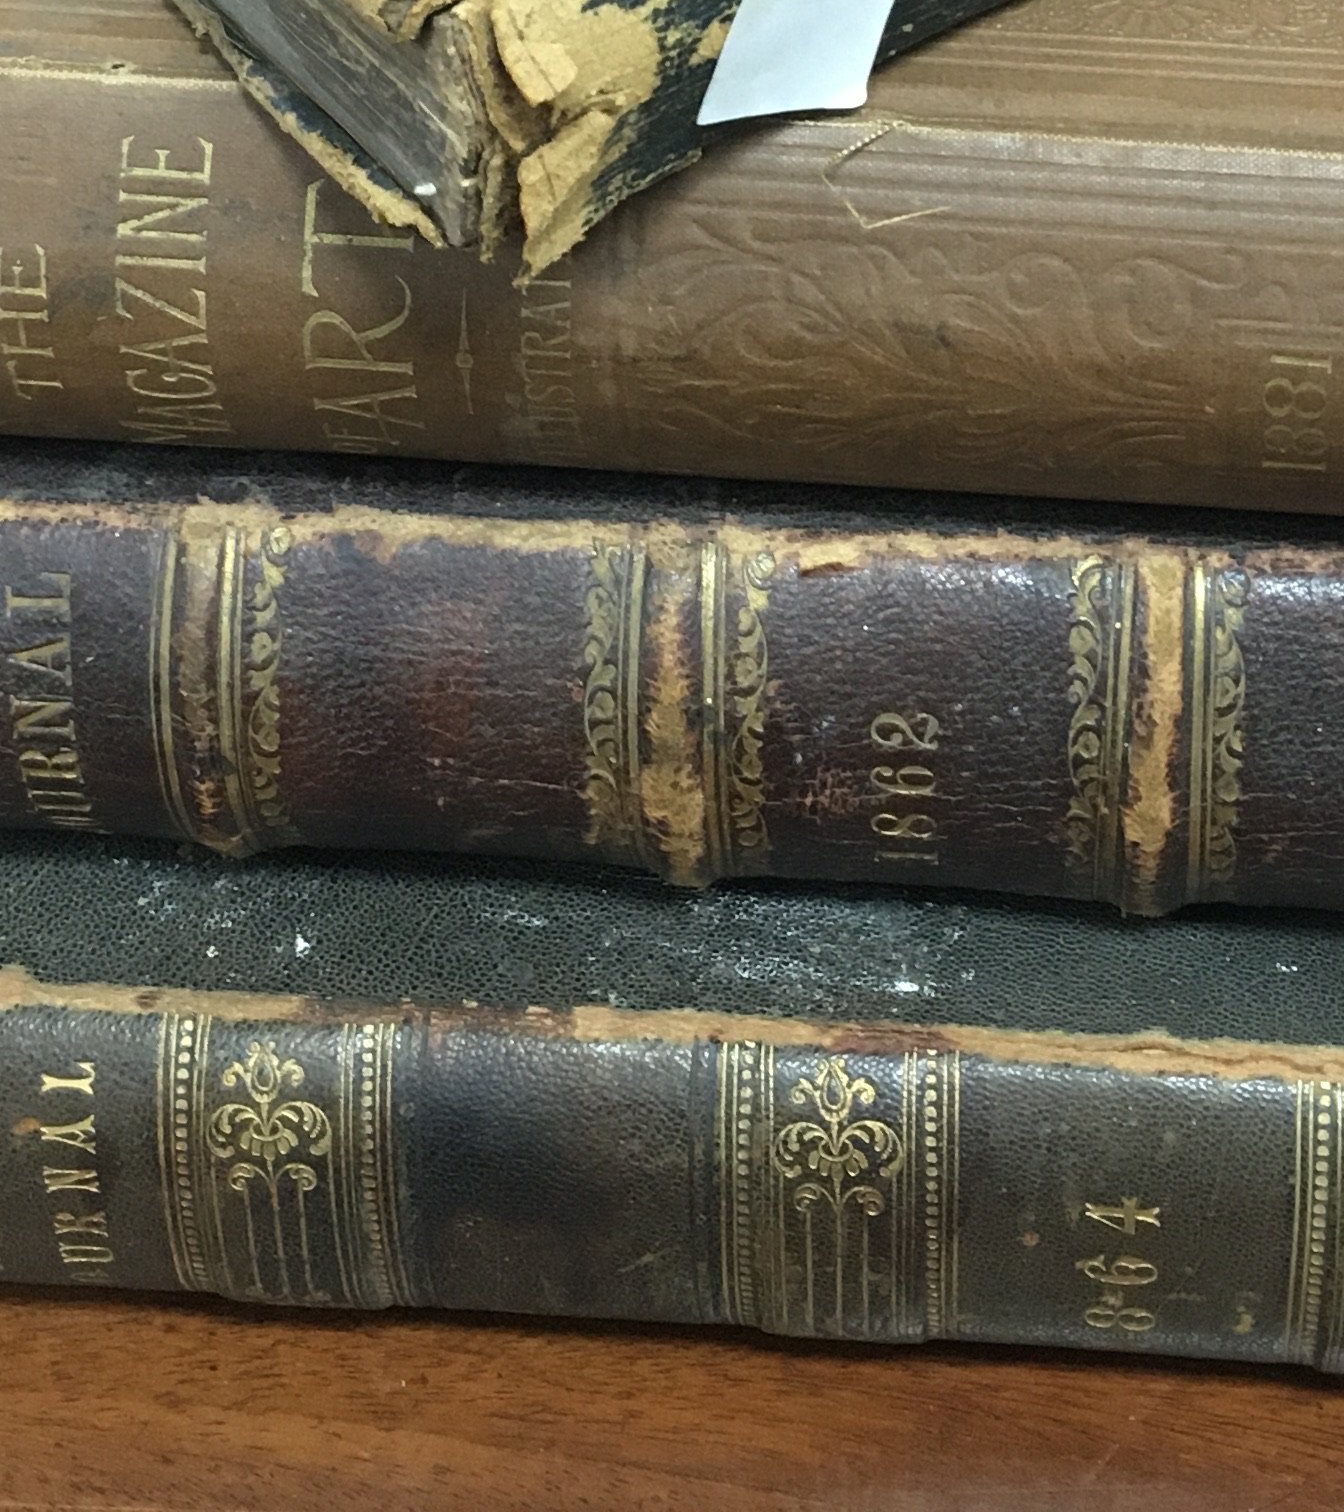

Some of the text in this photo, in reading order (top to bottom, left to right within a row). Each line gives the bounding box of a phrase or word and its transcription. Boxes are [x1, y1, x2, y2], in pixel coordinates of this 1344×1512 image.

[114, 134, 237, 443] MAGAZINE
[301, 178, 426, 444] ART
[1260, 353, 1333, 473] 1881
[5, 570, 99, 828] OURNAL
[869, 711, 940, 867] 1862
[1074, 1195, 1161, 1332] 864
